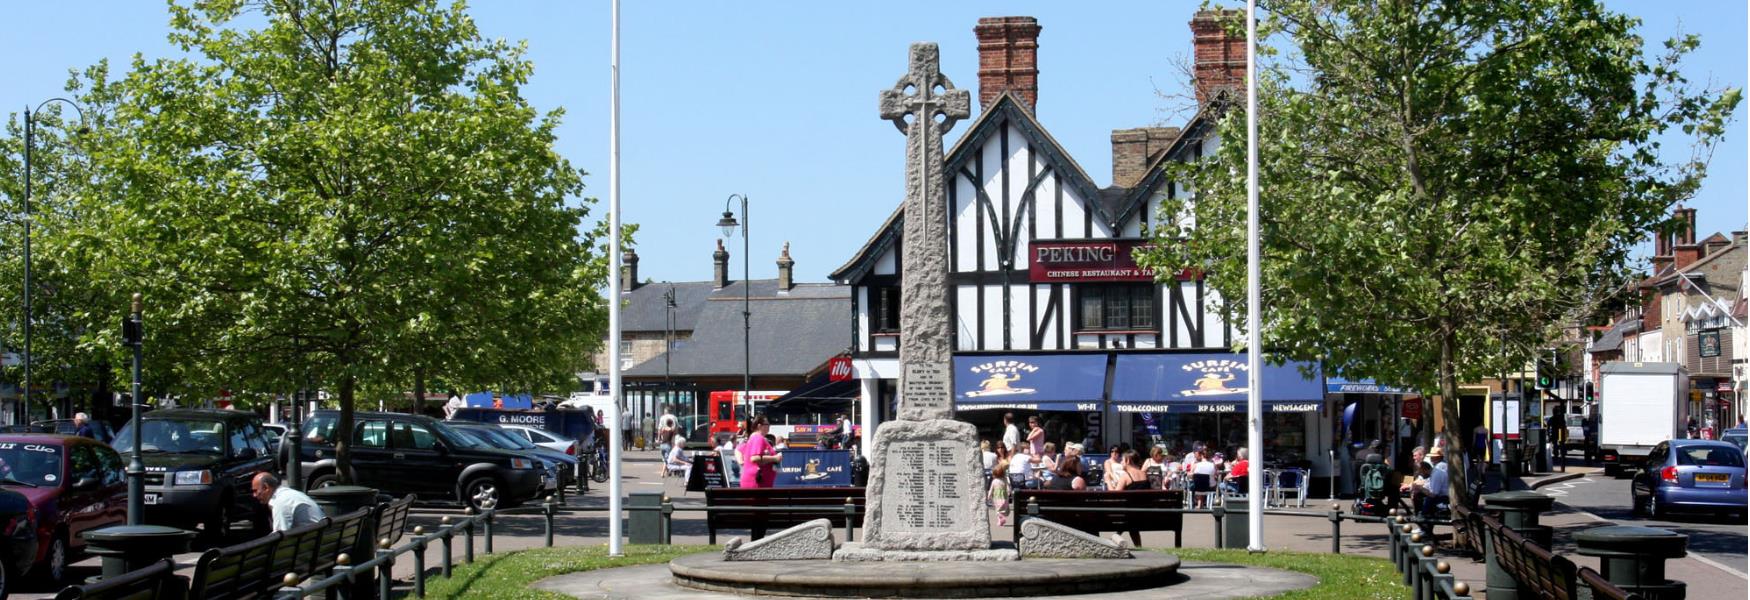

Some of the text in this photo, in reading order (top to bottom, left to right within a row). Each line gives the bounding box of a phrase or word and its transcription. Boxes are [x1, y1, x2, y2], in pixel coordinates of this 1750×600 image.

[1036, 246, 1114, 263] PEKING
[1047, 270, 1080, 278] CHINESE
[1082, 269, 1132, 277] RESTAURANT
[970, 360, 1040, 375] SURFIN
[1181, 359, 1249, 372] SURFIN
[831, 361, 851, 380] illy
[1077, 403, 1097, 411] WI-FI
[1117, 404, 1169, 412] TOBACCONIST
[1210, 404, 1215, 412] &
[1216, 404, 1235, 412] SONS
[1272, 403, 1319, 412] NEWSAGENT
[499, 415, 545, 424] G. MOORE
